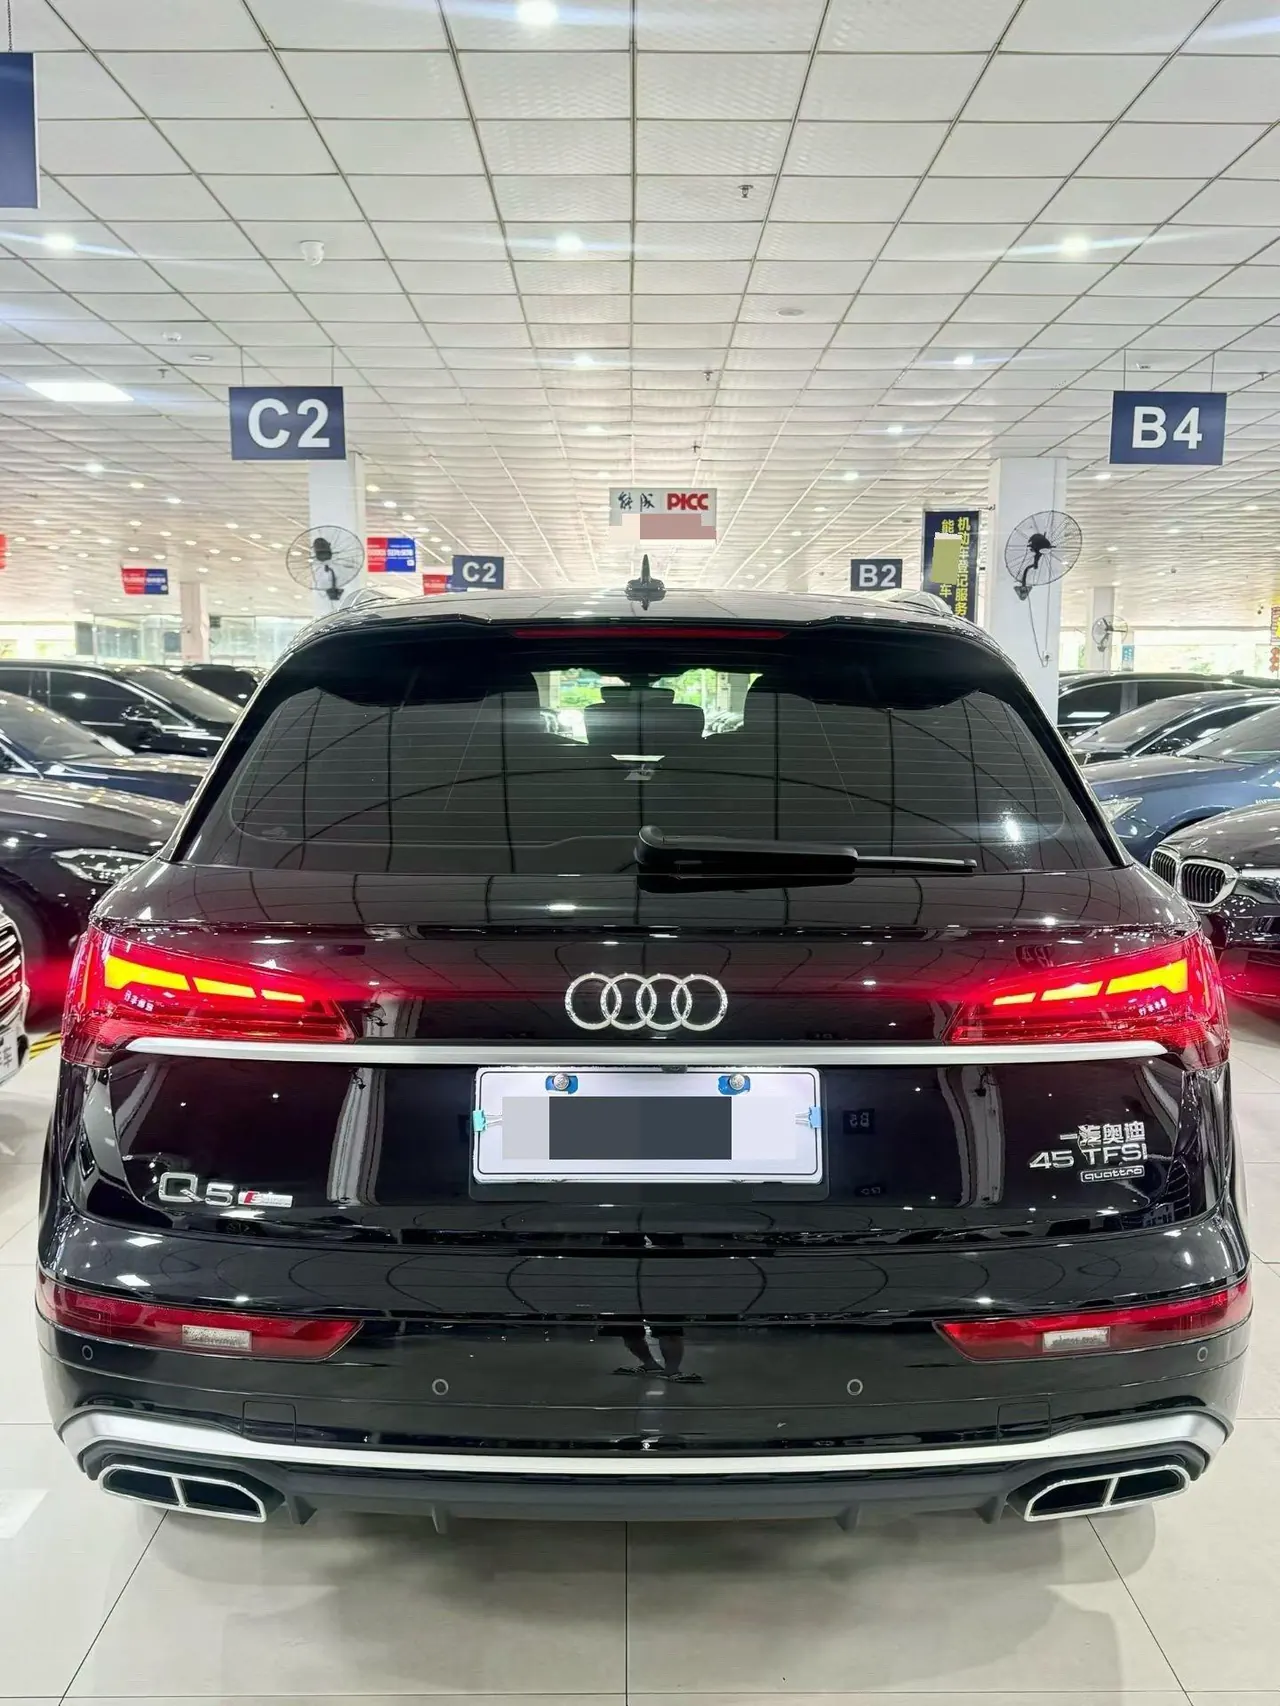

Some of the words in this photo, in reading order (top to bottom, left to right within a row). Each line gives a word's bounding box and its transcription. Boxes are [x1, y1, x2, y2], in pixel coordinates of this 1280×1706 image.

[248, 398, 330, 449] C2
[1132, 406, 1203, 450] B4
[667, 493, 709, 511] PICC
[462, 561, 497, 583] C2
[859, 564, 896, 587] B2
[1029, 1150, 1075, 1169] 45
[1081, 1142, 1148, 1165] TFSI
[1084, 1168, 1142, 1181] quattro
[158, 1172, 233, 1207] Q5
